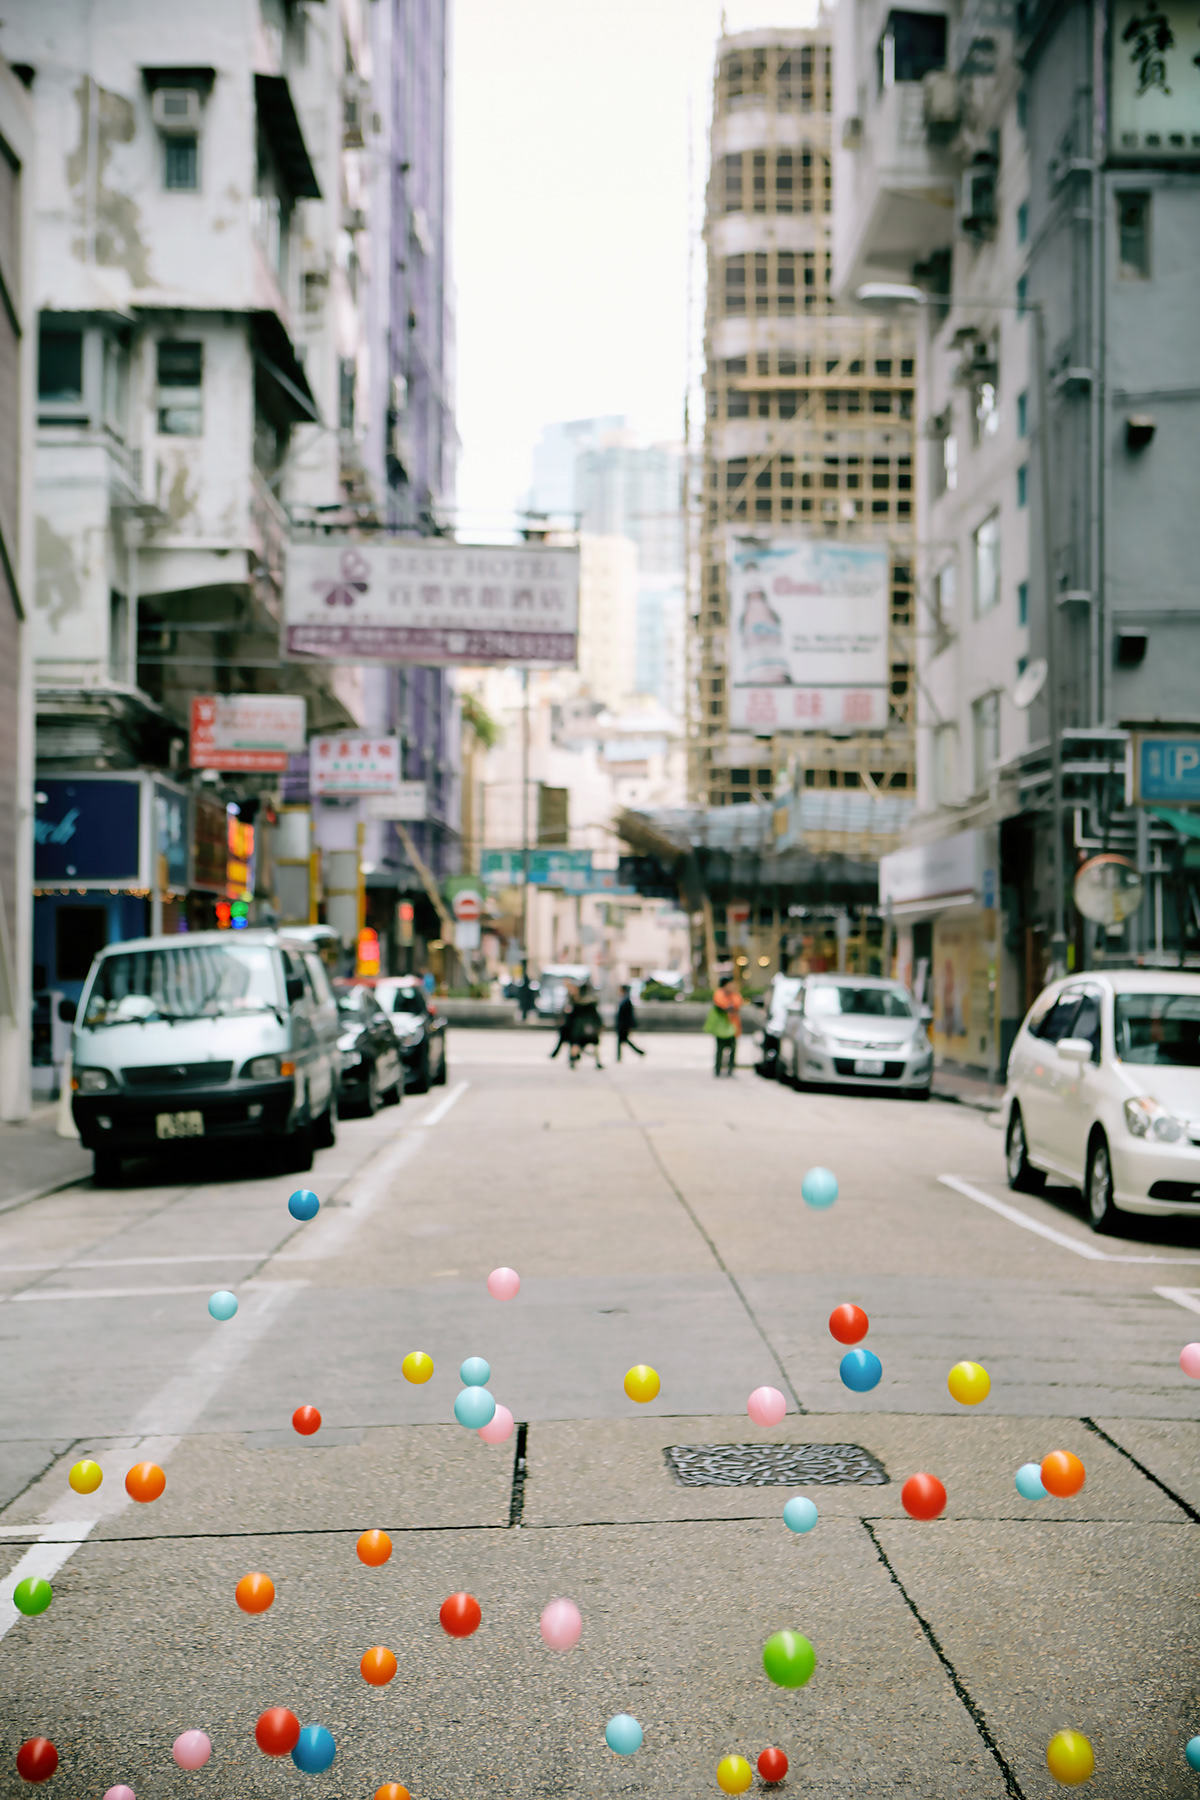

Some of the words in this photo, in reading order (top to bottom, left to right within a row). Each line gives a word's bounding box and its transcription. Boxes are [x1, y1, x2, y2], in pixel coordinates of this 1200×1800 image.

[388, 555, 456, 577] BEST
[465, 556, 564, 579] HOTEL
[1176, 747, 1200, 780] P
